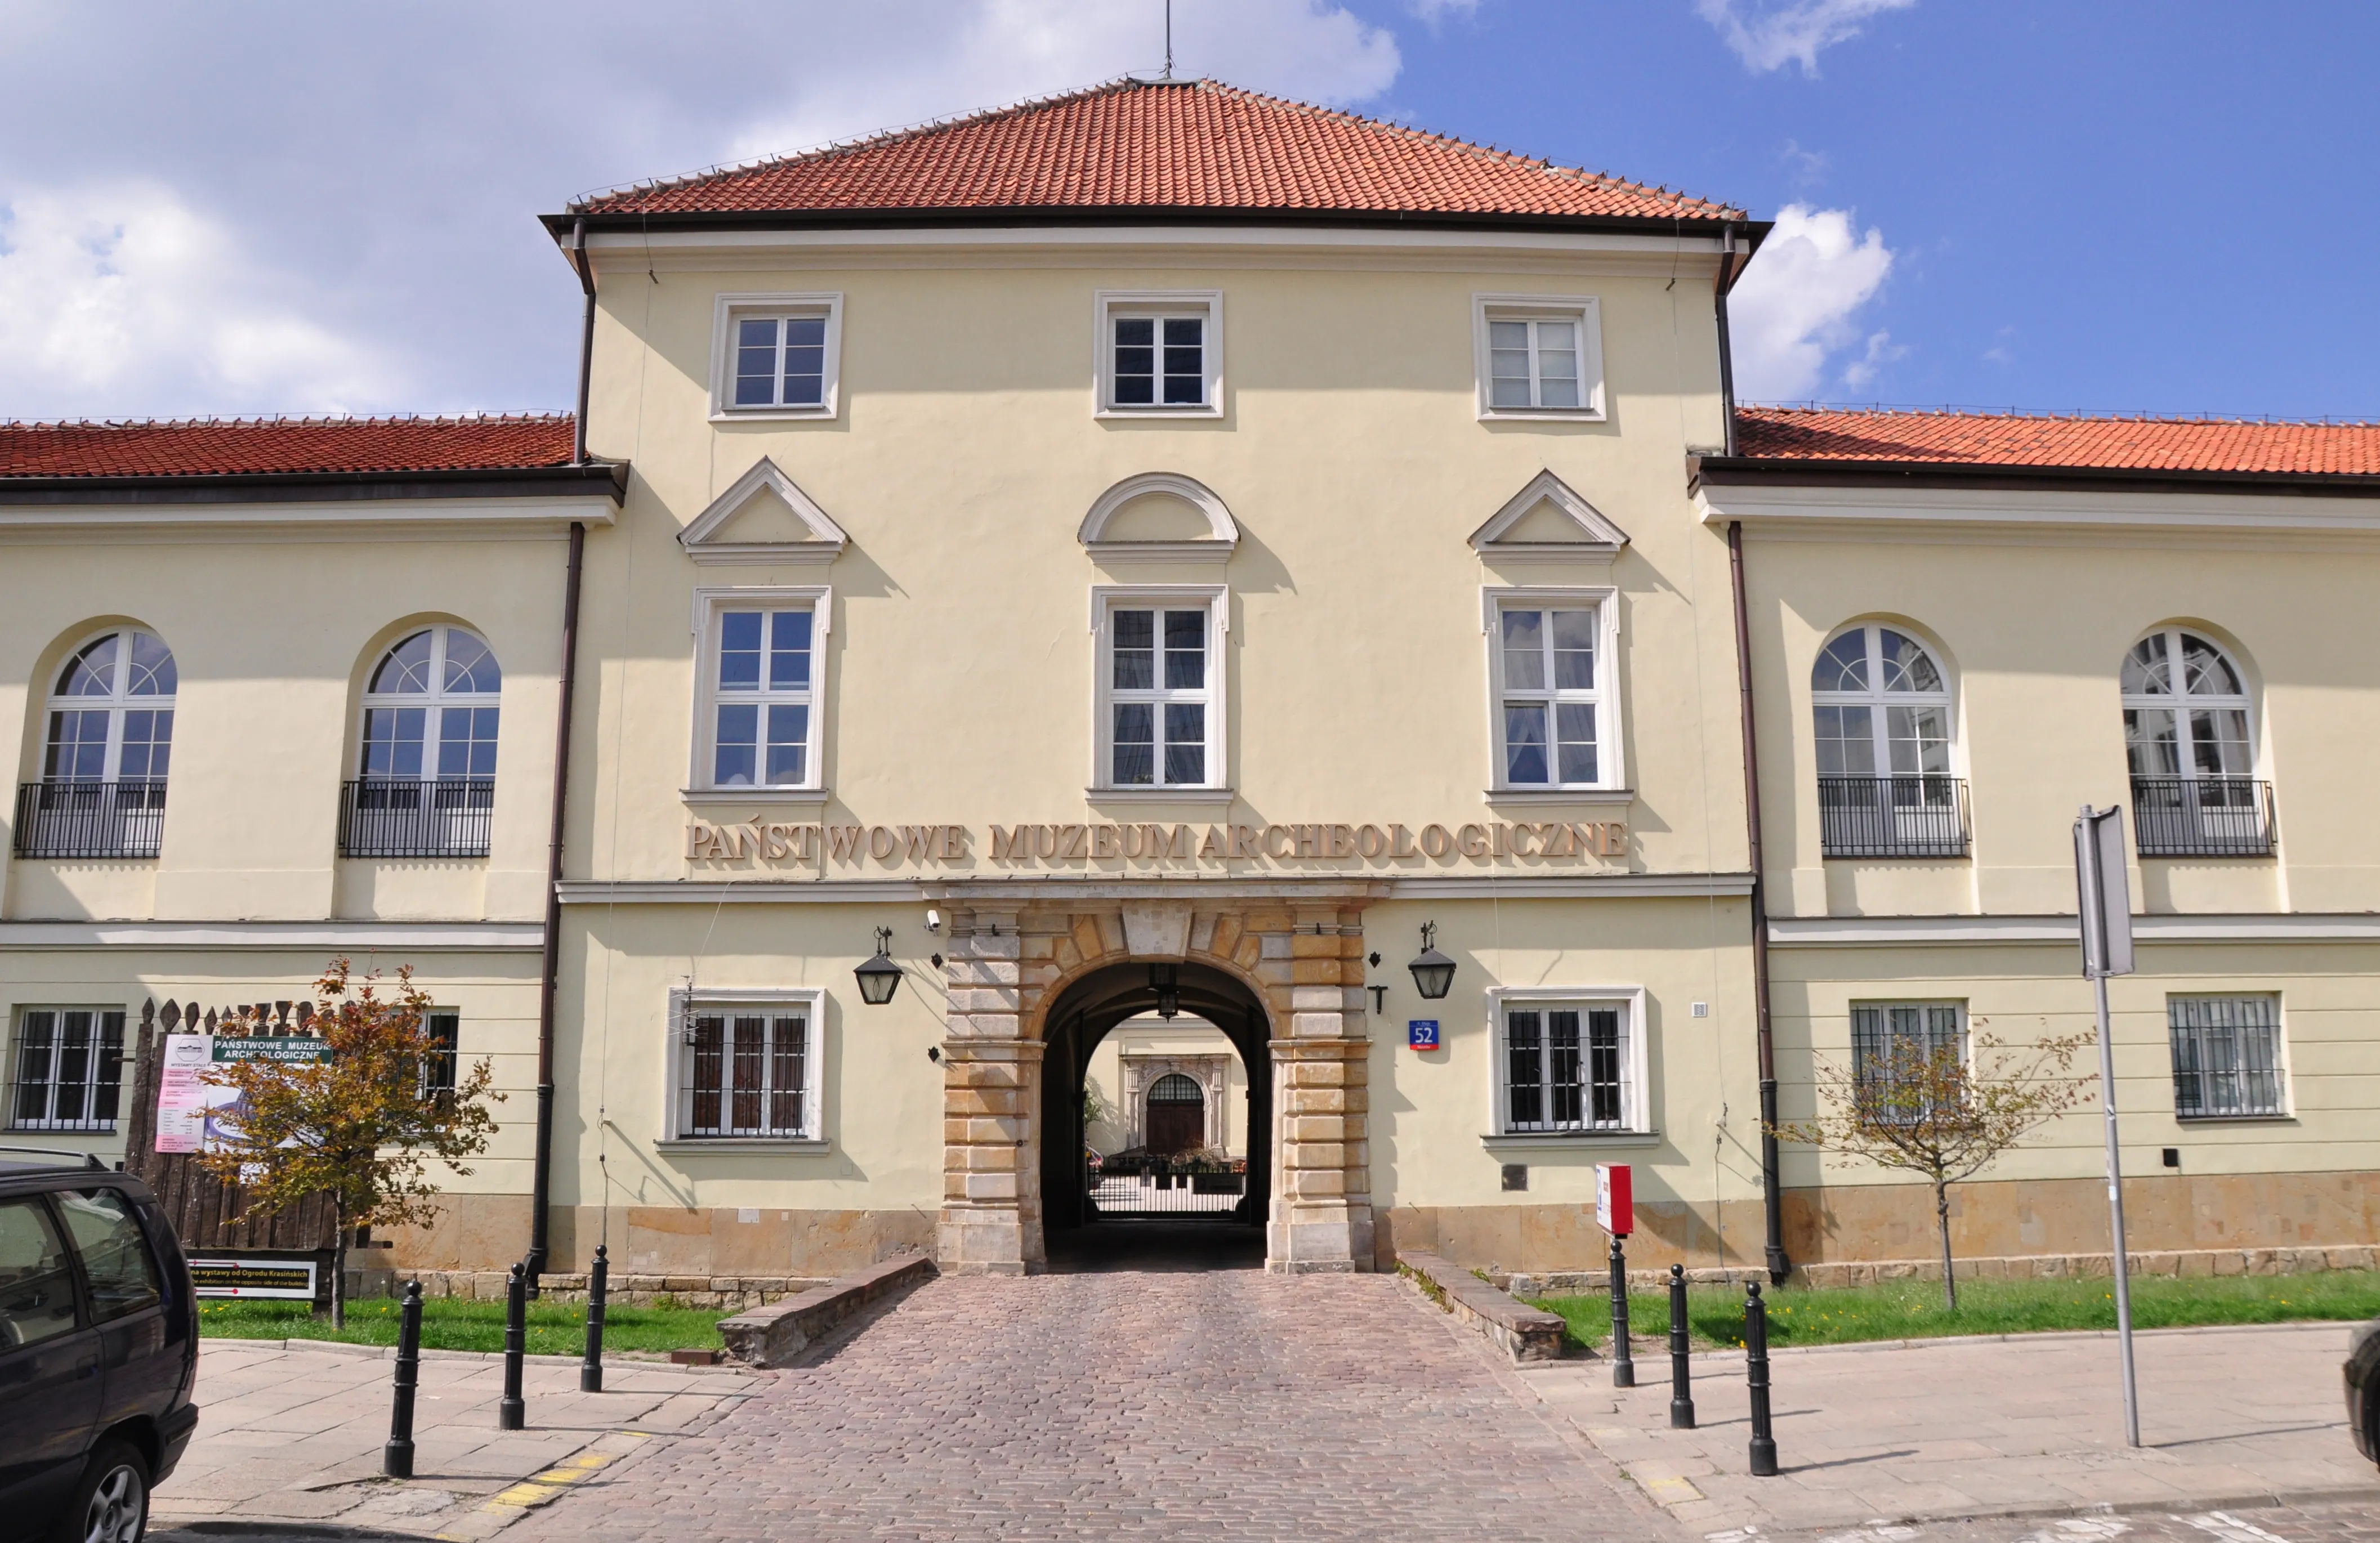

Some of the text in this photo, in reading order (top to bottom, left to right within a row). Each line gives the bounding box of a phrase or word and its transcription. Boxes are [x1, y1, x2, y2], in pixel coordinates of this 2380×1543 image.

[685, 813, 1628, 861] PAŃSTWOWE MUZEUM ARCHEOLOGICZNE
[1415, 1027, 1433, 1043] 52
[215, 1039, 282, 1050] PAŃSTWOWE
